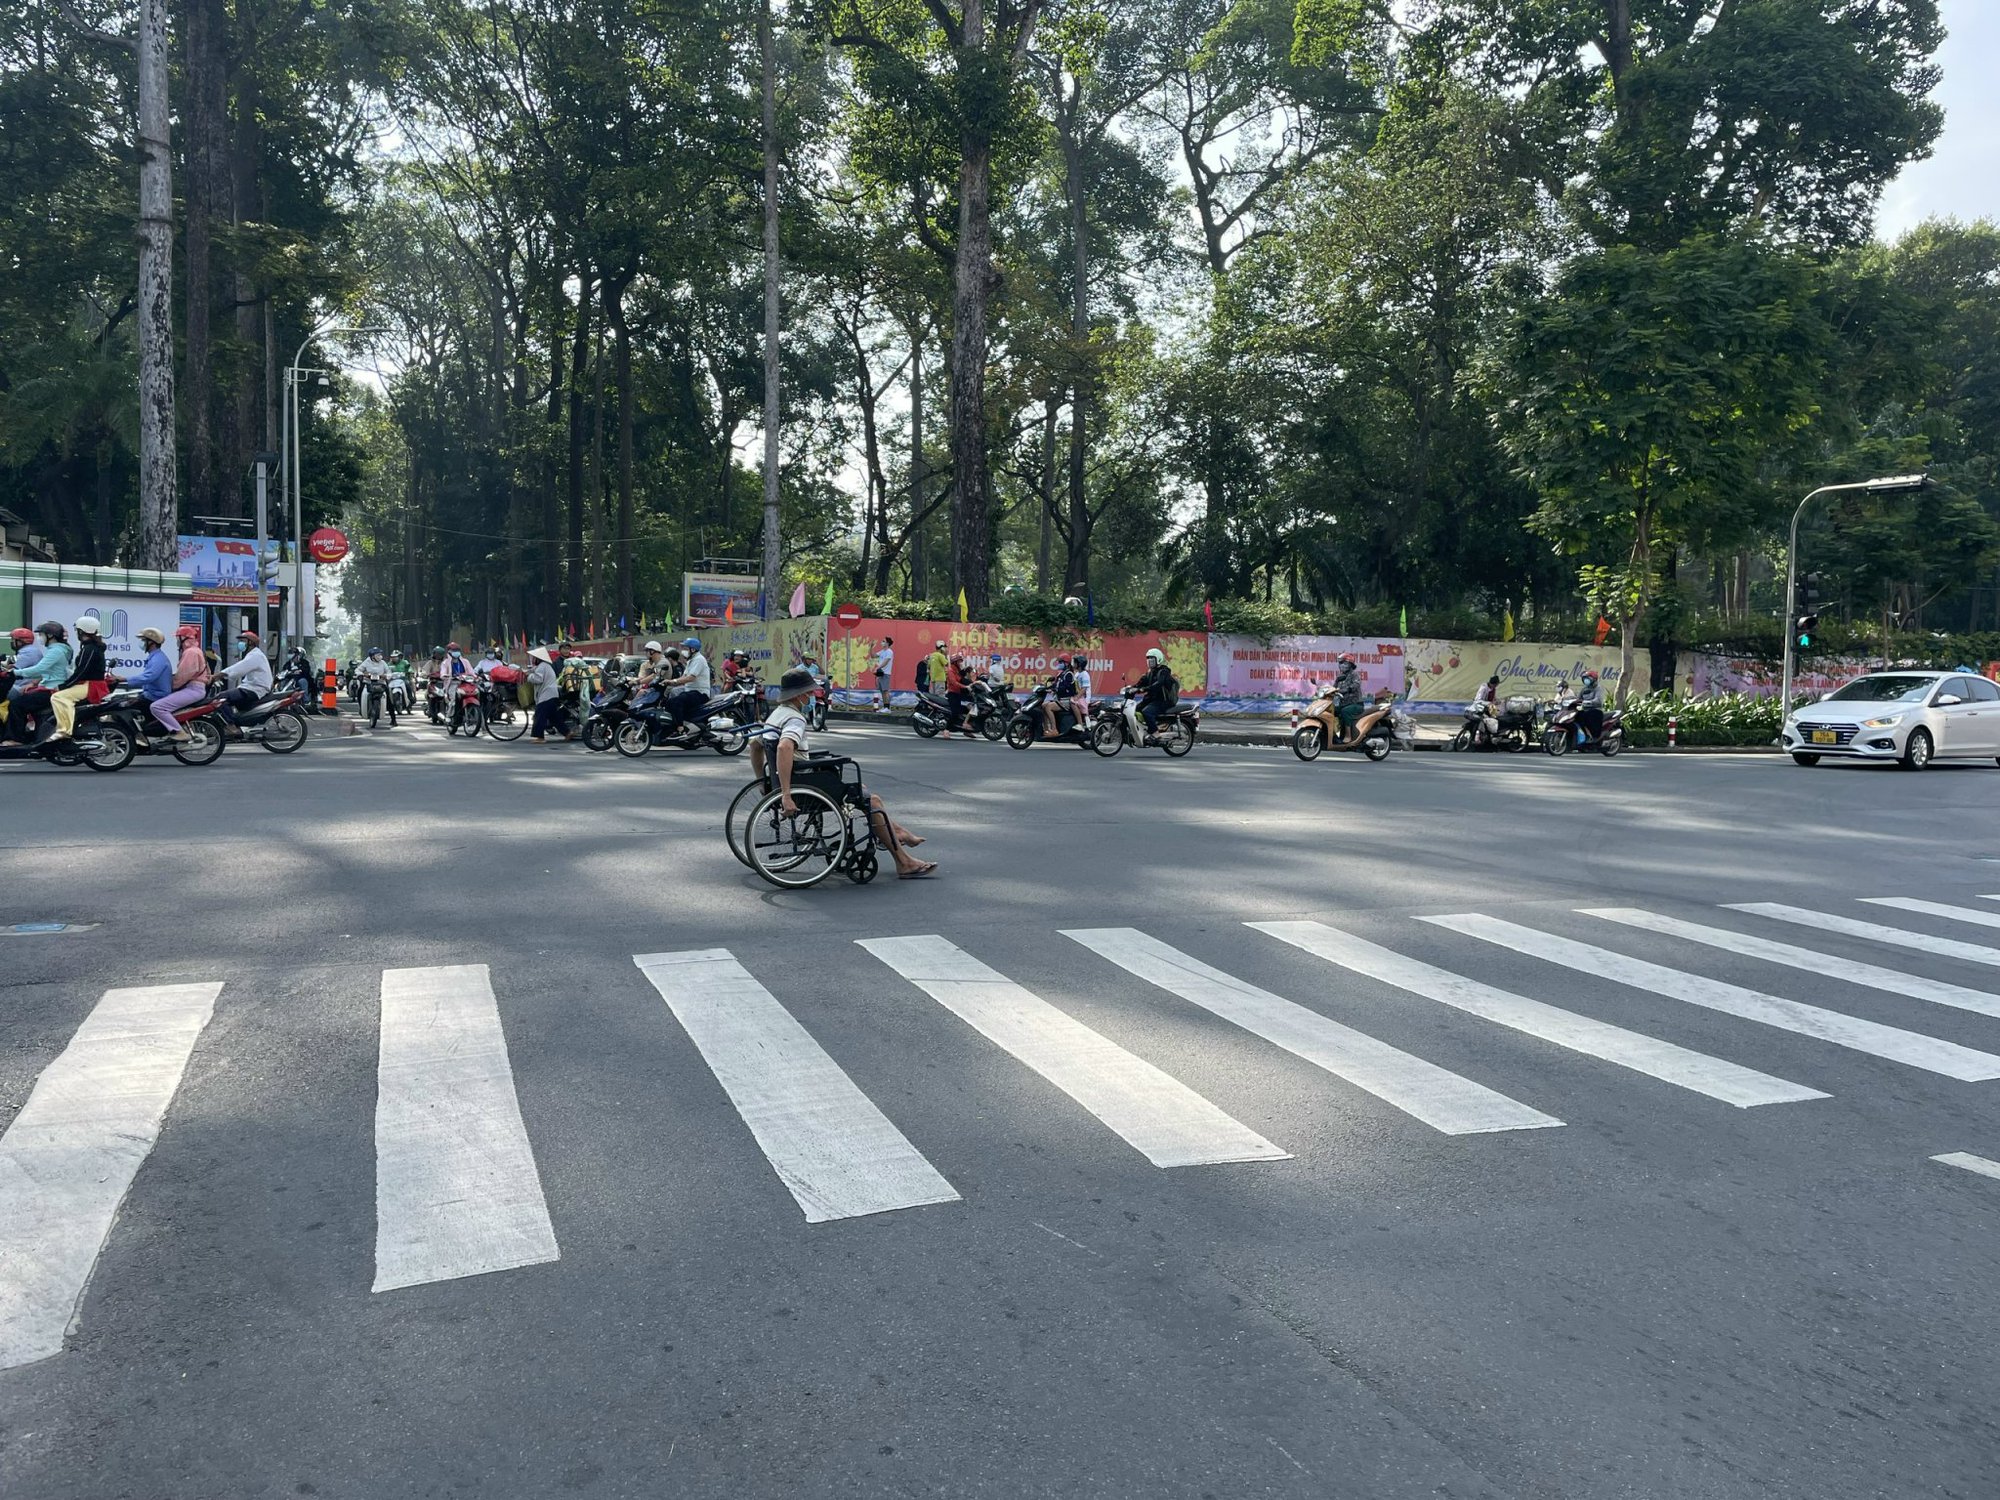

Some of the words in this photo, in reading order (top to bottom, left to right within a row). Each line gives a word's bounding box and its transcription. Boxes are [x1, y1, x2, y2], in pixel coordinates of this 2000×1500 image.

[217, 577, 254, 589] 2023
[696, 608, 717, 616] 2023
[950, 630, 989, 651] HỘI
[1494, 655, 1535, 684] Chúc
